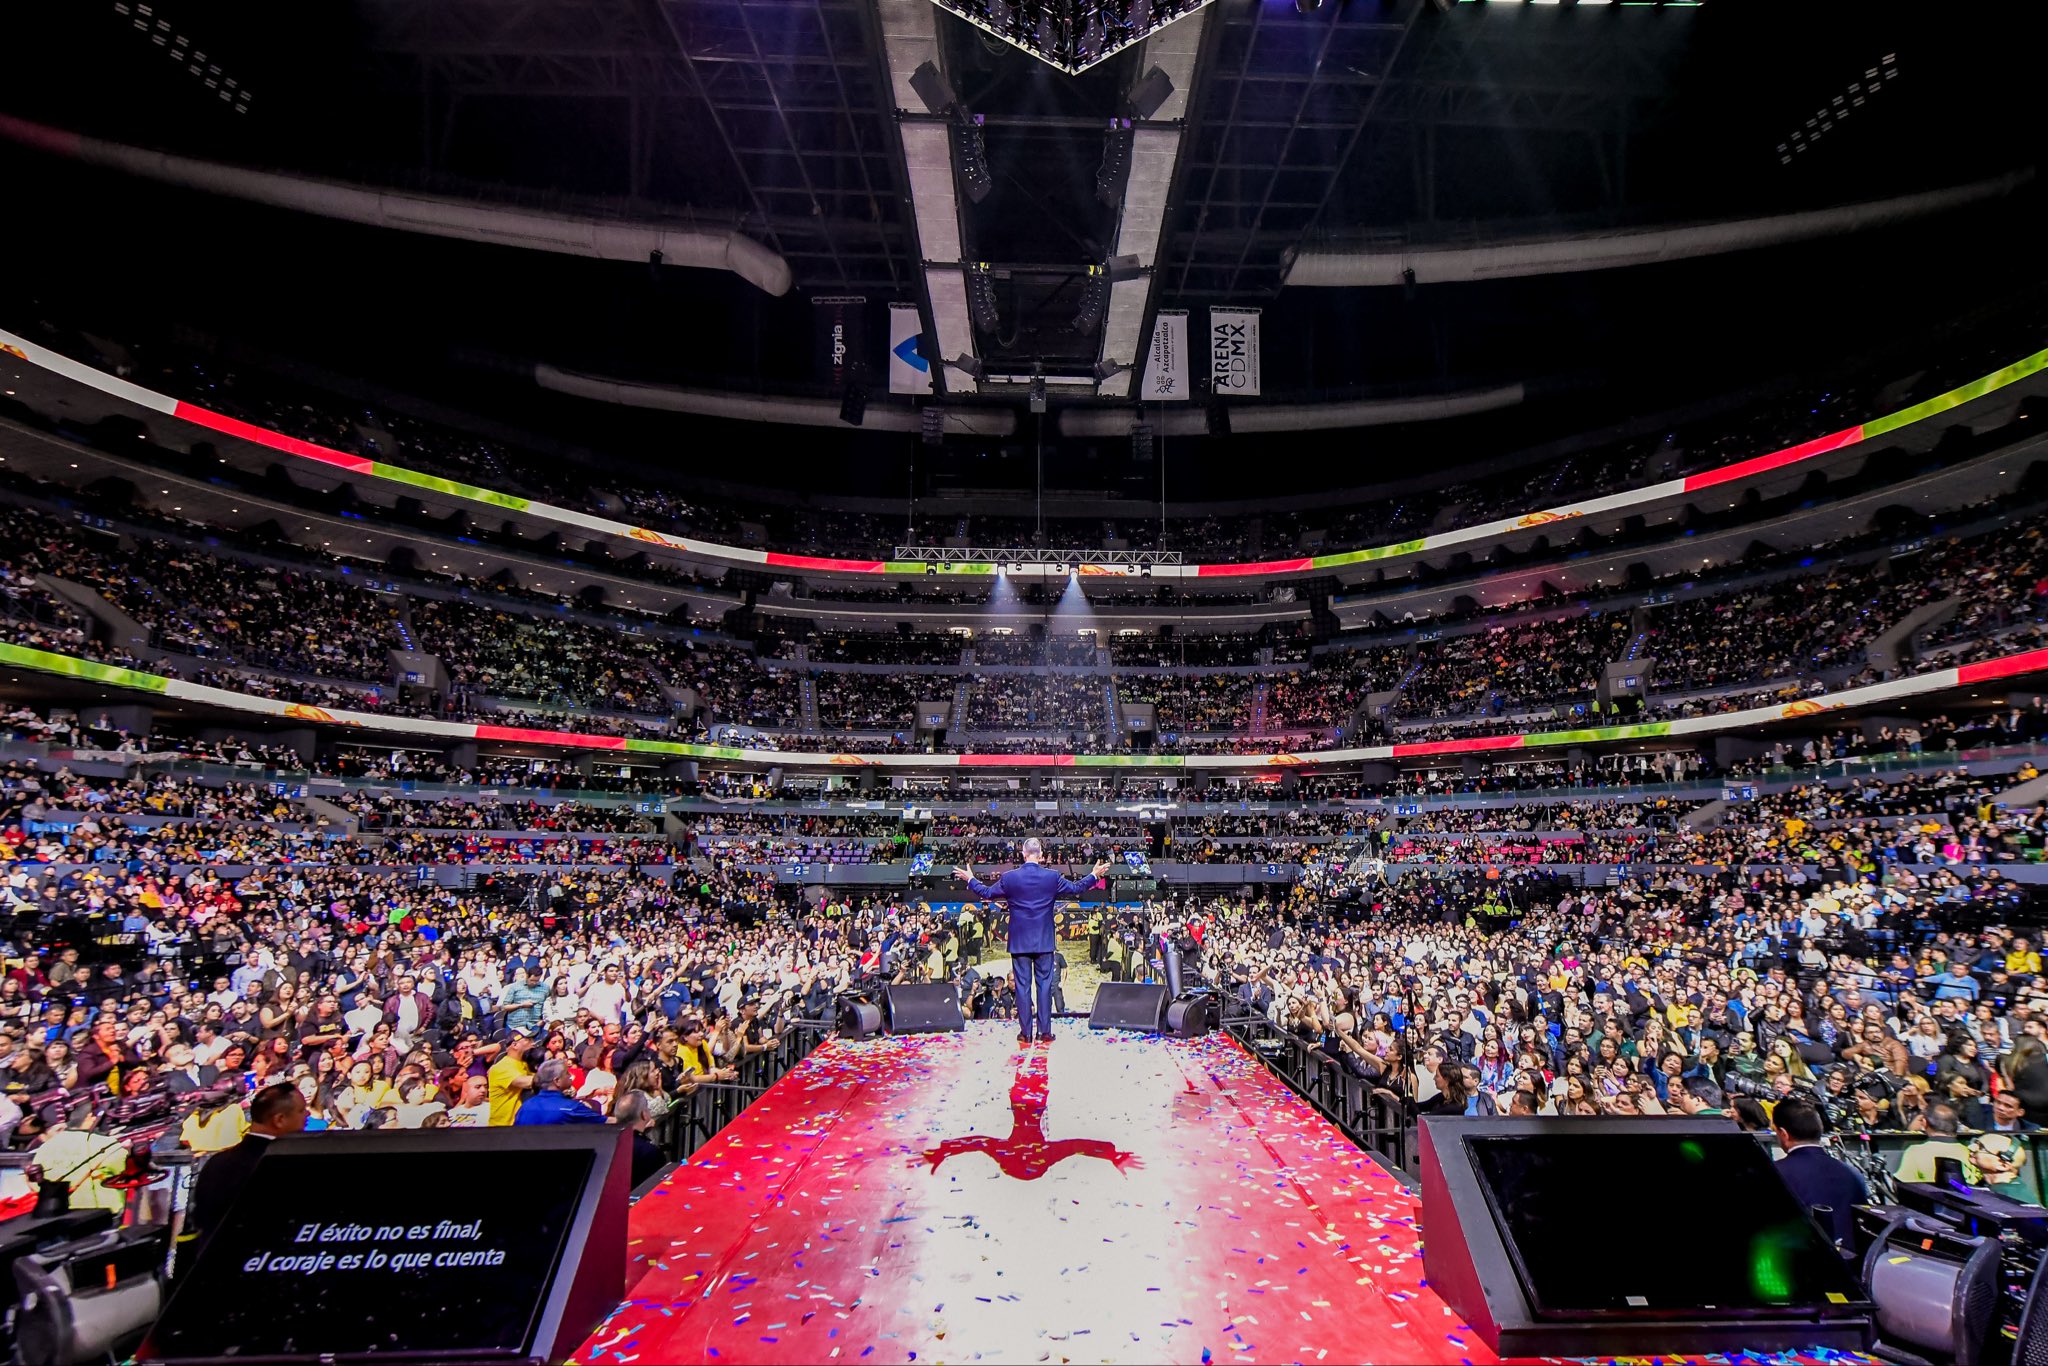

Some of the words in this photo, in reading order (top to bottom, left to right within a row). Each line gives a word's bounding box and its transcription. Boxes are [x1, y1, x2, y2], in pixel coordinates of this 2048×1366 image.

[832, 324, 846, 365] zignia
[1161, 321, 1170, 373] Azcapotzalco
[1214, 323, 1230, 388] ARENA
[1230, 323, 1246, 388] CDMX
[794, 866, 802, 875] 2
[1269, 865, 1276, 875] 3
[294, 1222, 321, 1242] El
[319, 1222, 373, 1242] éxito
[373, 1225, 405, 1241] no
[406, 1225, 432, 1240] es
[432, 1219, 483, 1241] final,
[243, 1251, 272, 1272] el
[268, 1250, 336, 1276] coraje
[336, 1254, 364, 1270] es
[363, 1248, 388, 1269] lo
[389, 1252, 433, 1273] que
[434, 1248, 507, 1268] cuenta
